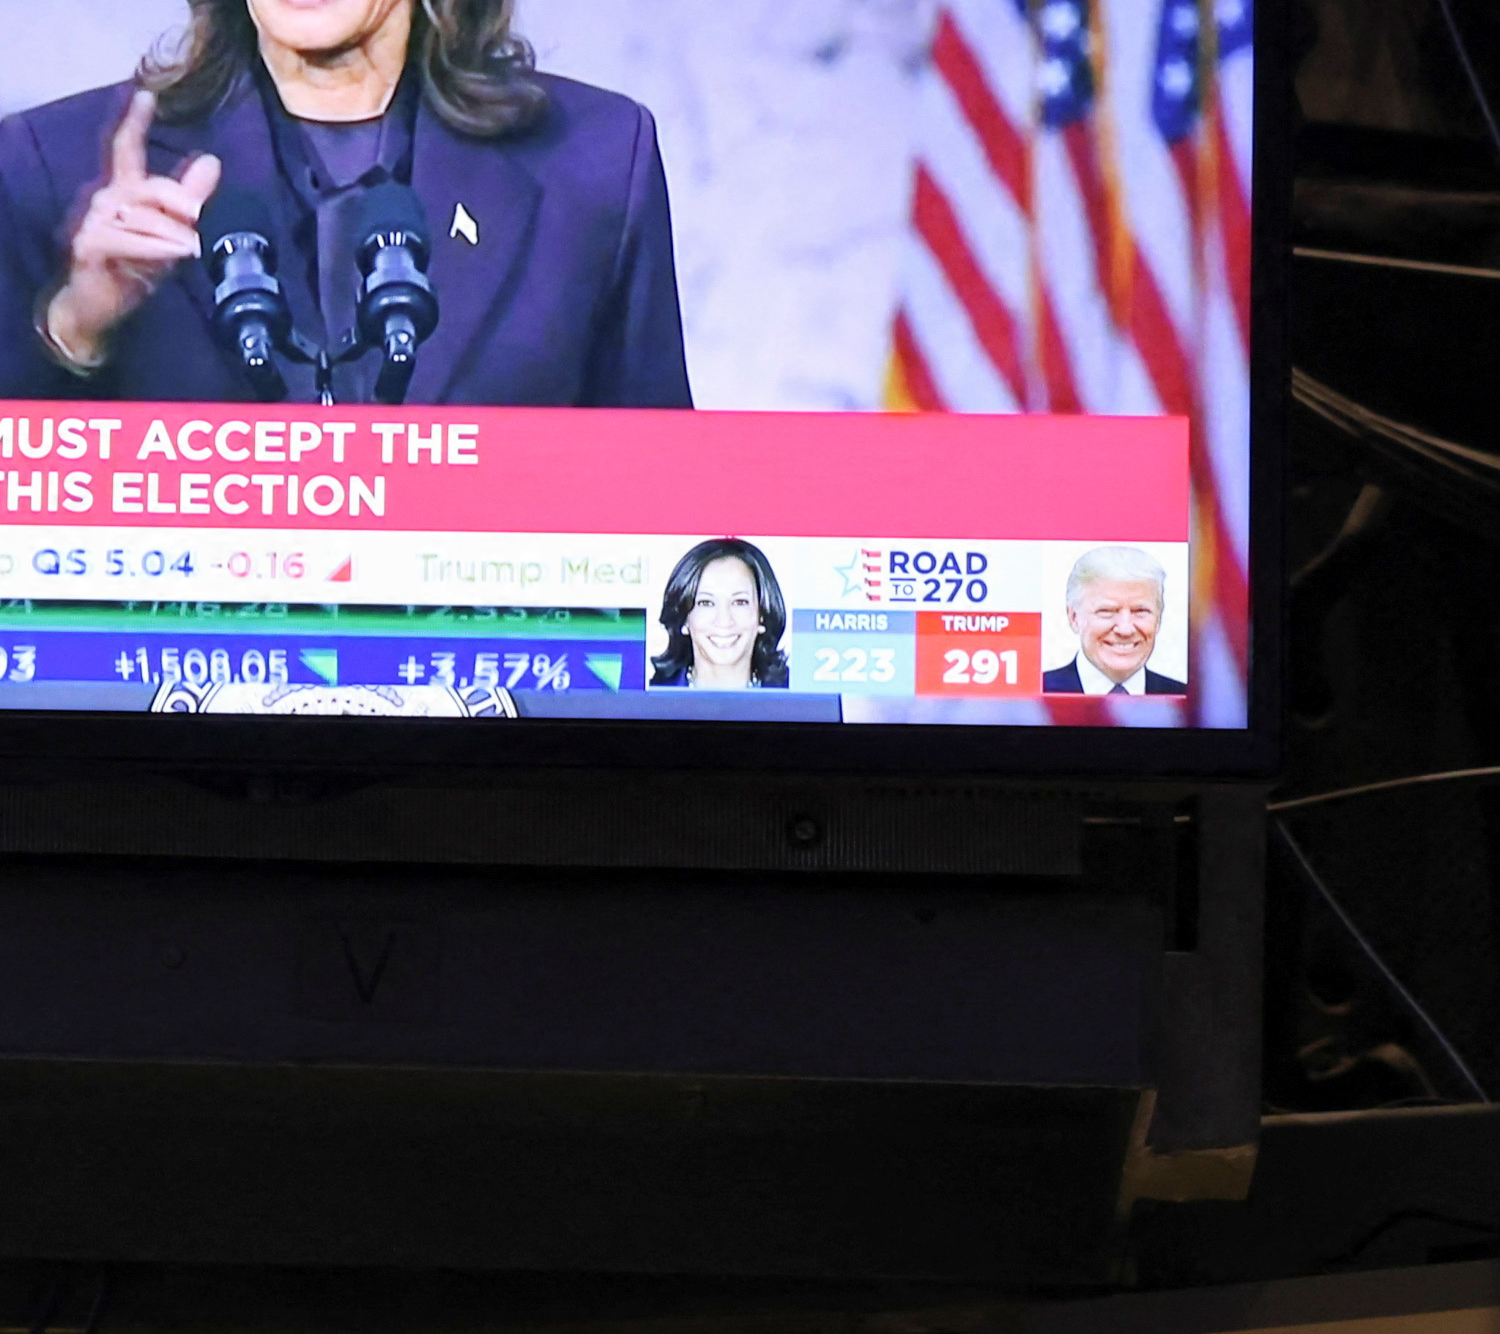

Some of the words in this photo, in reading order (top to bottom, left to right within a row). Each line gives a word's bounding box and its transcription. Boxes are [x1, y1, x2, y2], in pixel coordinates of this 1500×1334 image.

[137, 420, 355, 463] ACCEPT
[371, 424, 479, 465] THE
[112, 474, 386, 516] ELECTION
[32, 549, 87, 577] QS
[105, 549, 194, 578] 5.04
[210, 552, 306, 580] -0.16
[418, 554, 542, 588] Trump
[889, 551, 988, 577] ROAD
[892, 583, 915, 597] TO
[922, 579, 988, 603] 270
[816, 613, 889, 632] HARRIS
[942, 615, 1010, 633] TRUMP
[813, 648, 897, 683] 223
[943, 650, 1019, 685] 291
[340, 931, 397, 1004] V
